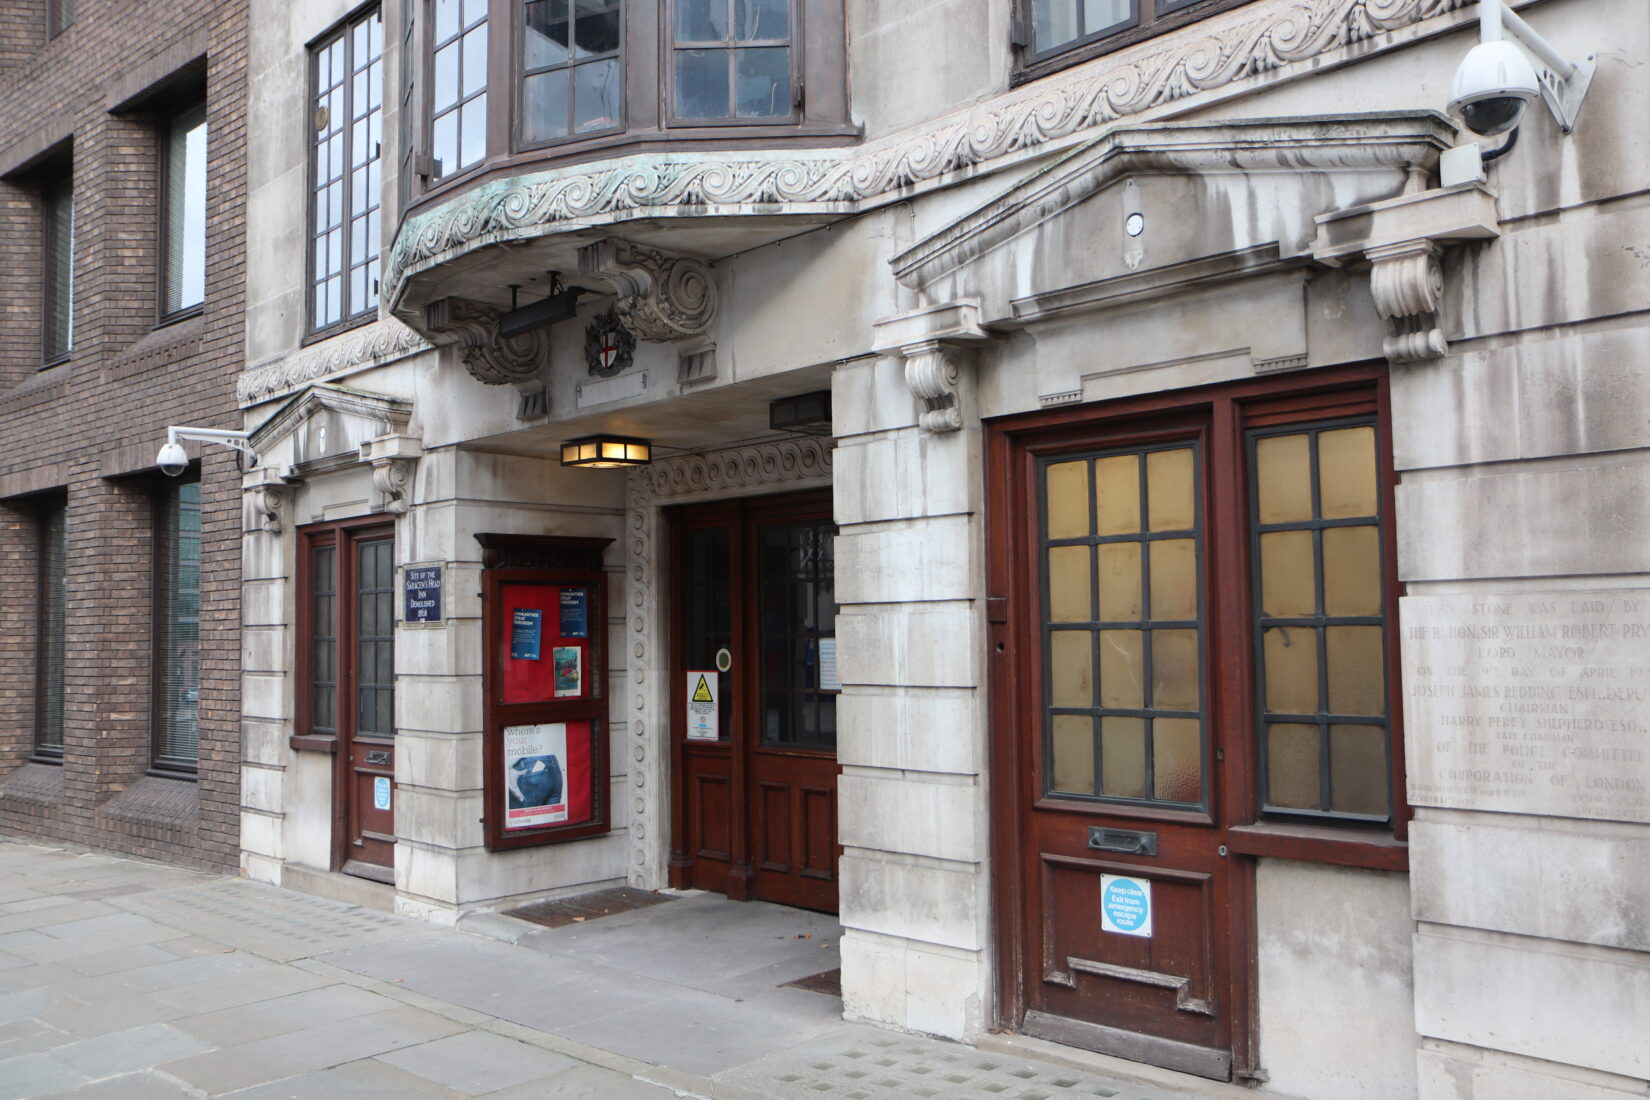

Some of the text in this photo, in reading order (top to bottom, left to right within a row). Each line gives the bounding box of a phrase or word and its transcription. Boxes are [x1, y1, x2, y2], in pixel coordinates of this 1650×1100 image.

[411, 570, 436, 580] SITE OF THE
[428, 579, 441, 589] HEAD
[418, 590, 427, 599] INN
[411, 599, 436, 608] DEMOLISHED
[1472, 602, 1512, 616] STONE
[1528, 602, 1557, 615] WAS
[1571, 600, 1605, 614] LAID
[1624, 599, 1640, 613] BY
[1409, 625, 1428, 640] THE
[1481, 625, 1499, 640] SIR
[1503, 623, 1557, 640] WILLIAM
[1562, 622, 1617, 640] ROBERT
[1478, 646, 1585, 659] LORD MAYOR
[1416, 665, 1433, 677] ON
[1447, 665, 1469, 677] THE
[1511, 666, 1535, 678] DAY
[1580, 666, 1617, 679] APRIL
[1411, 684, 1455, 698] JOSEPH
[1462, 684, 1500, 698] JAMES
[1499, 702, 1569, 714] CHAIRMAN
[1440, 714, 1481, 728] HARRY
[1488, 716, 1527, 729] PERCY
[1536, 717, 1604, 731] SHEPHERD
[507, 726, 542, 736] where's
[507, 736, 527, 745] your
[1522, 732, 1575, 743] CHAIRMAN
[508, 743, 544, 756] mobile?
[1436, 741, 1645, 762] OF THE POLICE COMMITTEE
[1439, 768, 1646, 792] CORPORATION OF LONDON
[1109, 885, 1143, 896] Keep clear
[1112, 895, 1140, 906] Exit from
[1108, 903, 1143, 915] emergency
